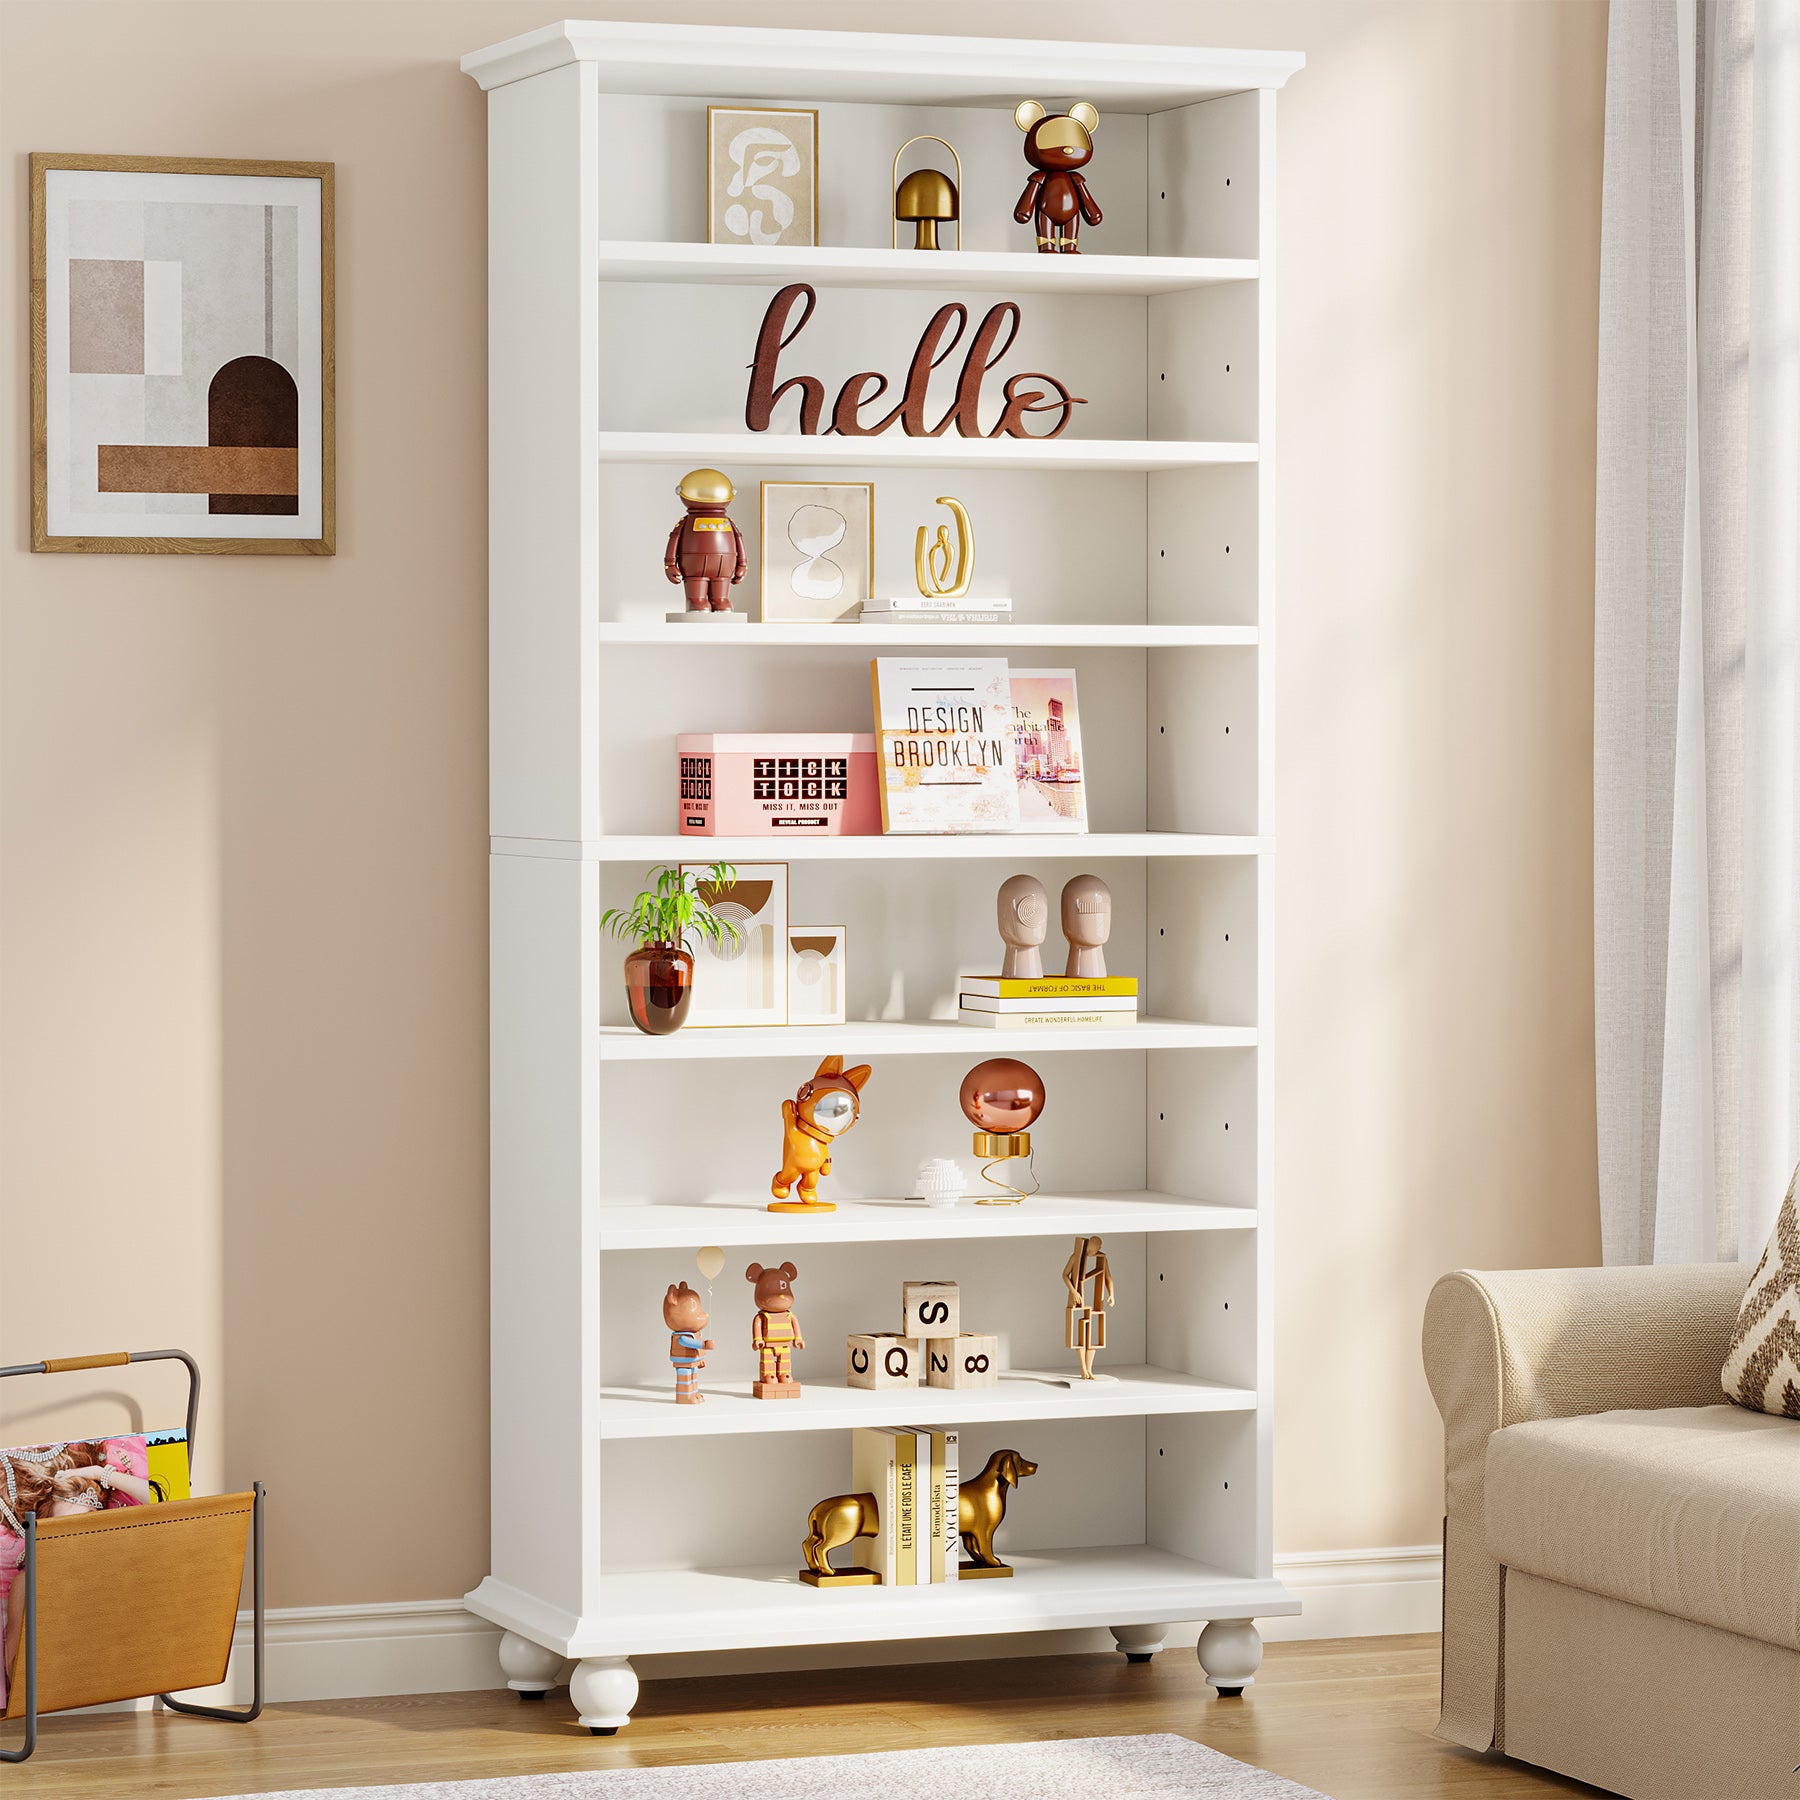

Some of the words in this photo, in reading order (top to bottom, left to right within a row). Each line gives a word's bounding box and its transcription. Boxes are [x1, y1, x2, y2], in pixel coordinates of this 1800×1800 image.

[745, 283, 1088, 439] hello
[907, 707, 984, 734] DESIGN
[893, 740, 1003, 767] BROOKLYN
[683, 761, 710, 776] TICK
[759, 761, 841, 776] TICK
[683, 782, 710, 797] TOCK
[759, 782, 841, 797] TOCK
[762, 803, 783, 811] MISS
[799, 803, 820, 811] MISS
[823, 803, 838, 811] OUT
[1029, 985, 1058, 993] FORMAT
[1071, 984, 1091, 992] BASIC
[1092, 984, 1106, 992] THE
[1045, 1016, 1076, 1024] WONDERFUL
[1077, 1015, 1103, 1023] HOMELIFE
[918, 1300, 949, 1325] S
[884, 1346, 909, 1378] Q
[931, 1351, 948, 1374] 2
[964, 1353, 990, 1374] 8
[902, 1482, 912, 1490] LE
[902, 1491, 912, 1506] FOIS
[902, 1508, 912, 1522] UNE
[932, 1484, 941, 1538] Remodelista
[945, 1469, 958, 1552] NOGUCHI
